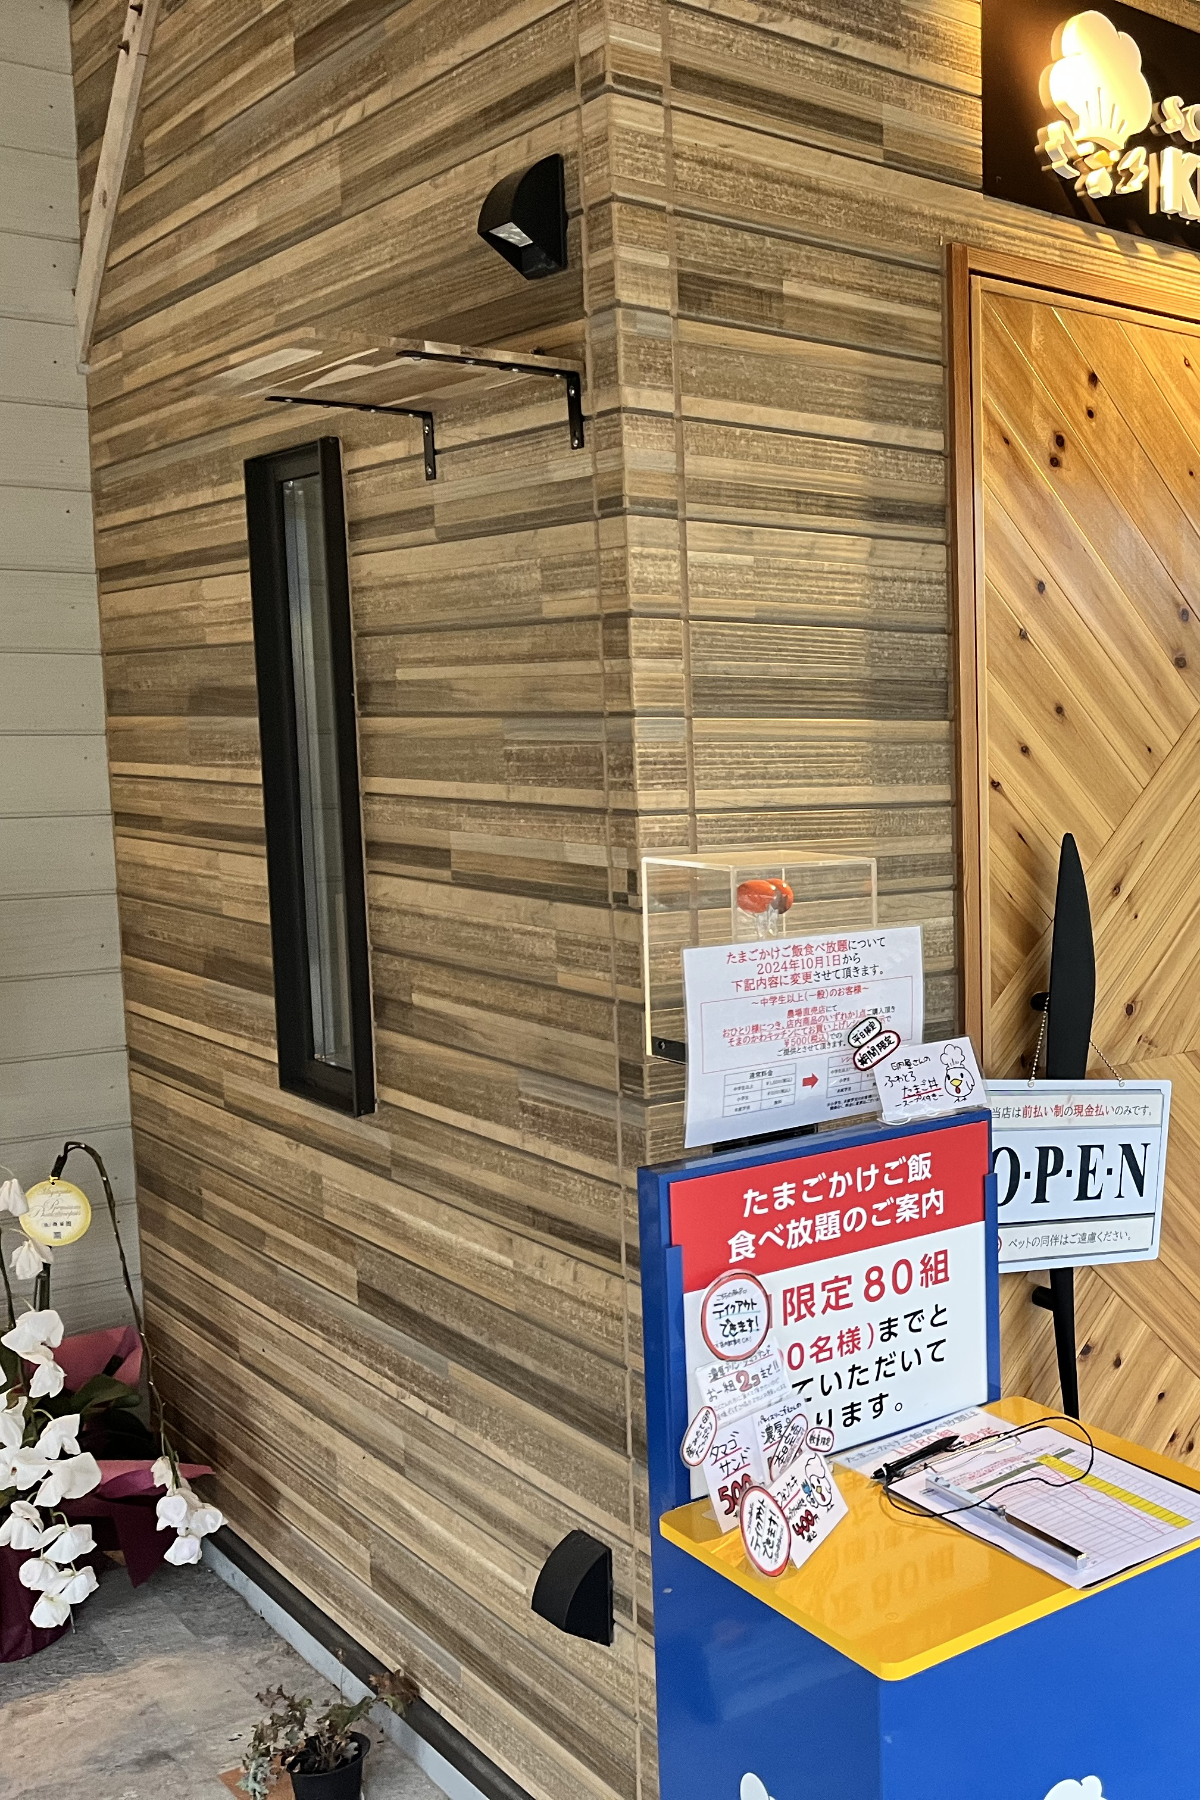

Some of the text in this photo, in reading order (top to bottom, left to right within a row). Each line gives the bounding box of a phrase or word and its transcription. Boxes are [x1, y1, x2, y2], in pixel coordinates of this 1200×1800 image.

[726, 936, 886, 965] たまごかけご飯食べ放題について
[756, 952, 862, 975] 2024年10月1日から
[732, 964, 886, 992] 下記内容に変更させて頂きます。
[992, 1103, 1152, 1120] 当店は前払い制の現金払いのみです。
[742, 1151, 933, 1218] たまごかけご飯
[726, 1187, 945, 1264] 食べ放題のご案内
[1008, 1231, 1131, 1249] ペットの同伴はご遠慮ください。
[768, 1249, 950, 1330] 限定80組
[712, 1298, 758, 1319] テイクアウト
[779, 1303, 949, 1371] 0名様）までと
[710, 1431, 740, 1462] タマゴ
[719, 1447, 751, 1478] サンド
